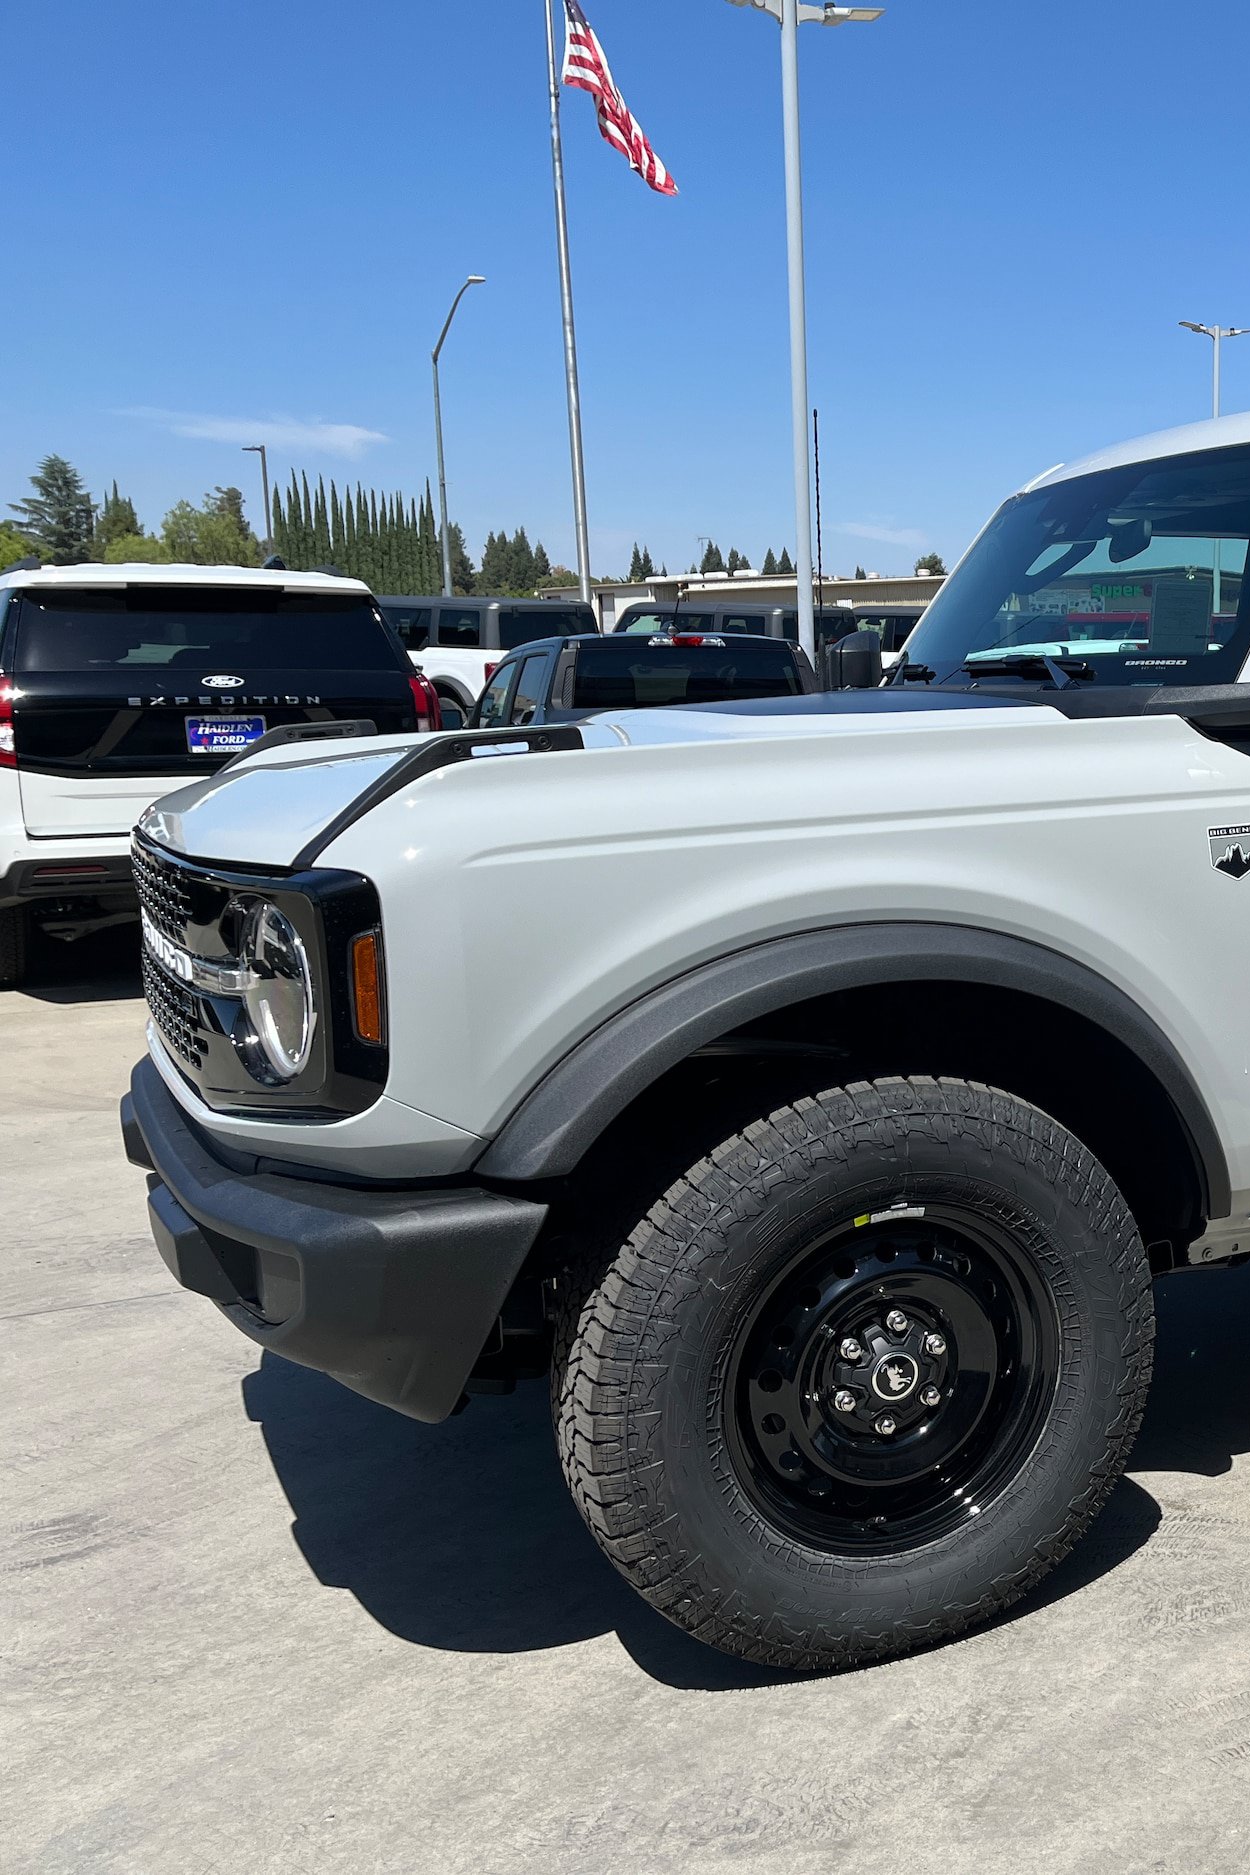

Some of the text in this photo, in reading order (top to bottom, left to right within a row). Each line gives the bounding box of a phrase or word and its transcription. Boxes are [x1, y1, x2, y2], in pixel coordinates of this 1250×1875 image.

[1124, 659, 1188, 667] BRONCO
[128, 696, 320, 706] EXPEDITION
[197, 722, 253, 735] HAIDLEN
[212, 735, 246, 745] FORD
[1209, 828, 1228, 837] BIG
